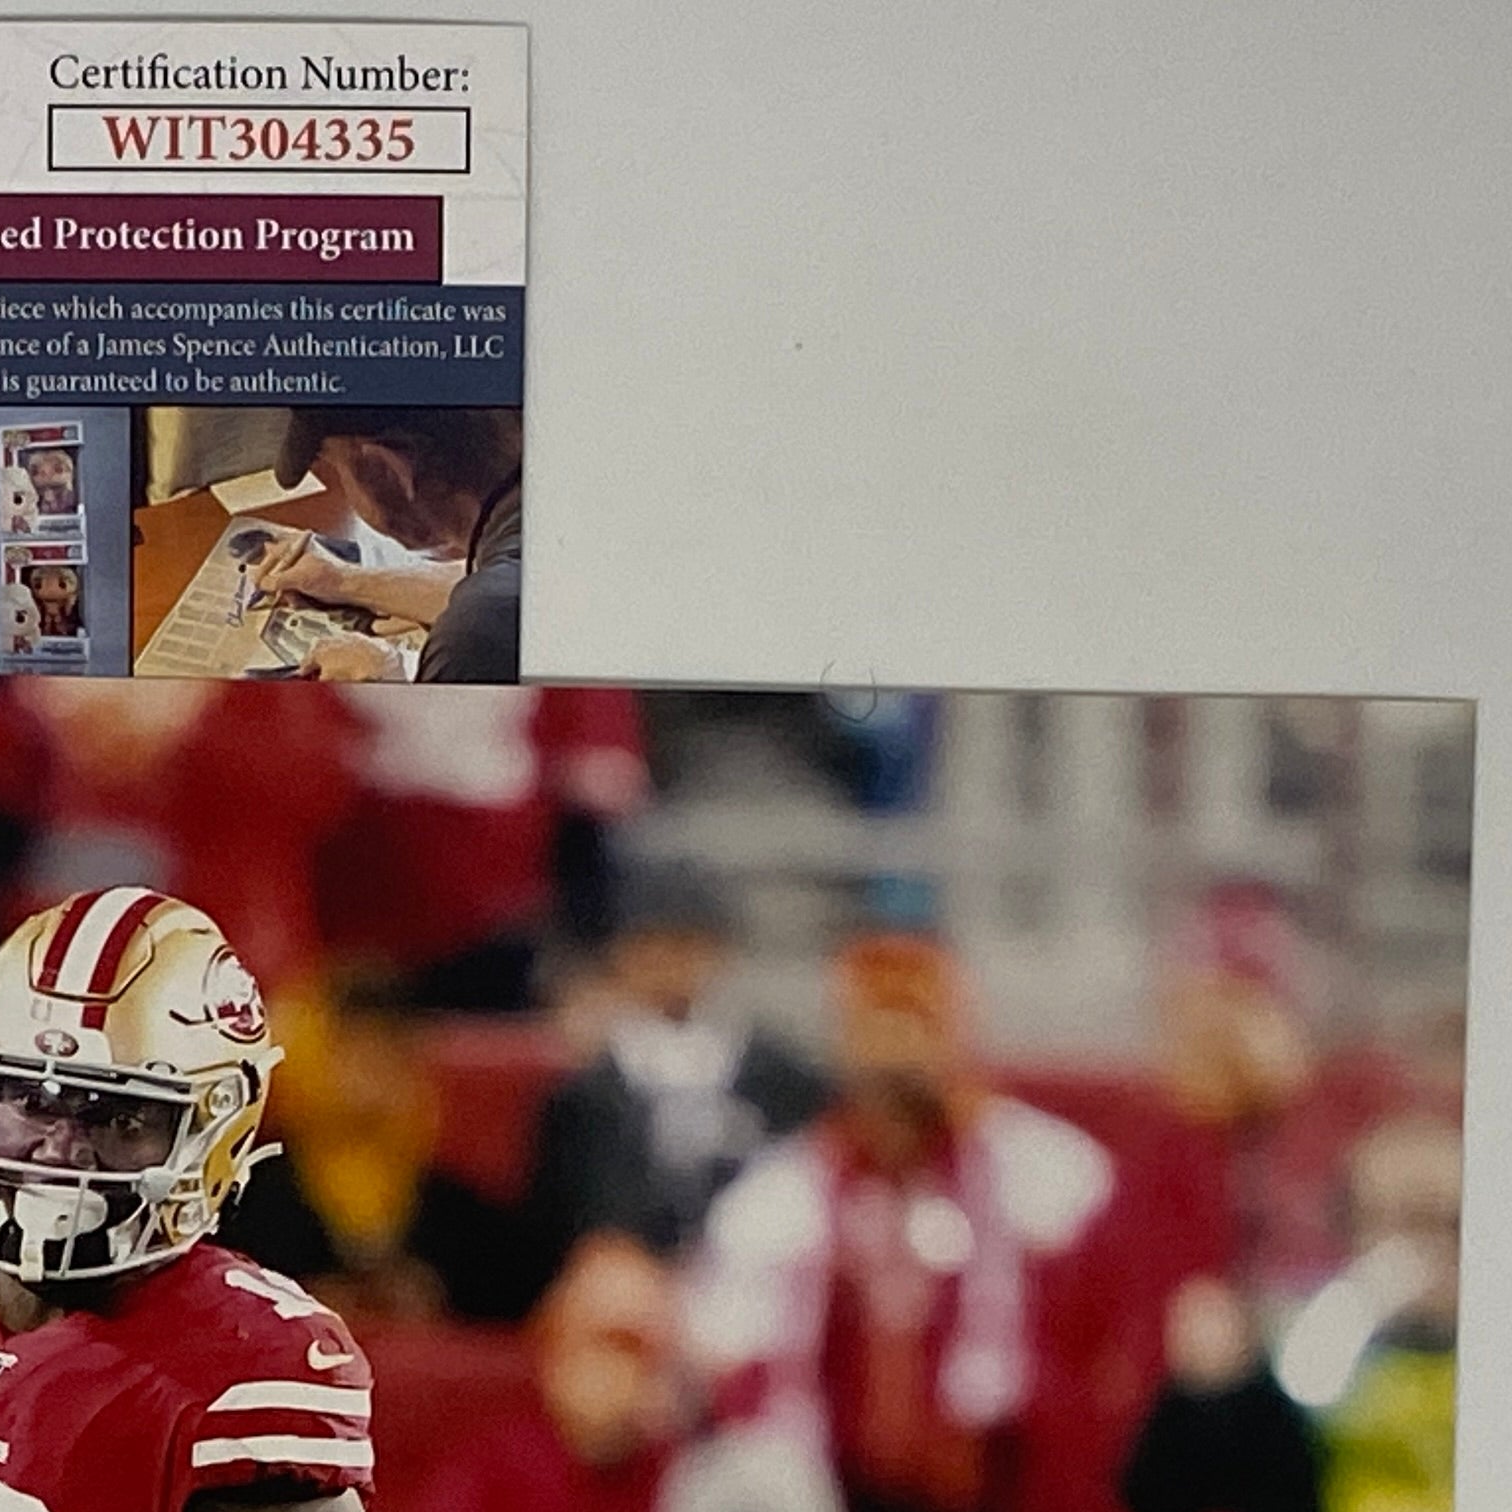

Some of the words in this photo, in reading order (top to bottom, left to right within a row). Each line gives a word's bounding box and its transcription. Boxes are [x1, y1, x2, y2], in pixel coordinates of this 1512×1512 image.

[49, 52, 288, 91] Certification
[300, 54, 471, 92] Number:
[102, 114, 416, 163] WIT304335
[53, 217, 244, 251] Protection
[255, 218, 416, 262] Program
[52, 296, 124, 320] which
[131, 297, 284, 328] accompanies
[290, 297, 335, 321] this
[340, 297, 457, 322] certificate
[463, 305, 507, 323] was
[46, 332, 75, 357] of
[76, 341, 90, 357] a
[96, 333, 166, 361] James
[173, 333, 255, 364] Spence
[262, 333, 448, 361] Authentication,
[453, 335, 505, 359] LLC
[1, 368, 21, 392] is
[25, 368, 158, 399] guaranteed
[165, 371, 188, 392] to
[195, 368, 224, 392] be
[229, 368, 347, 393] authentic.
